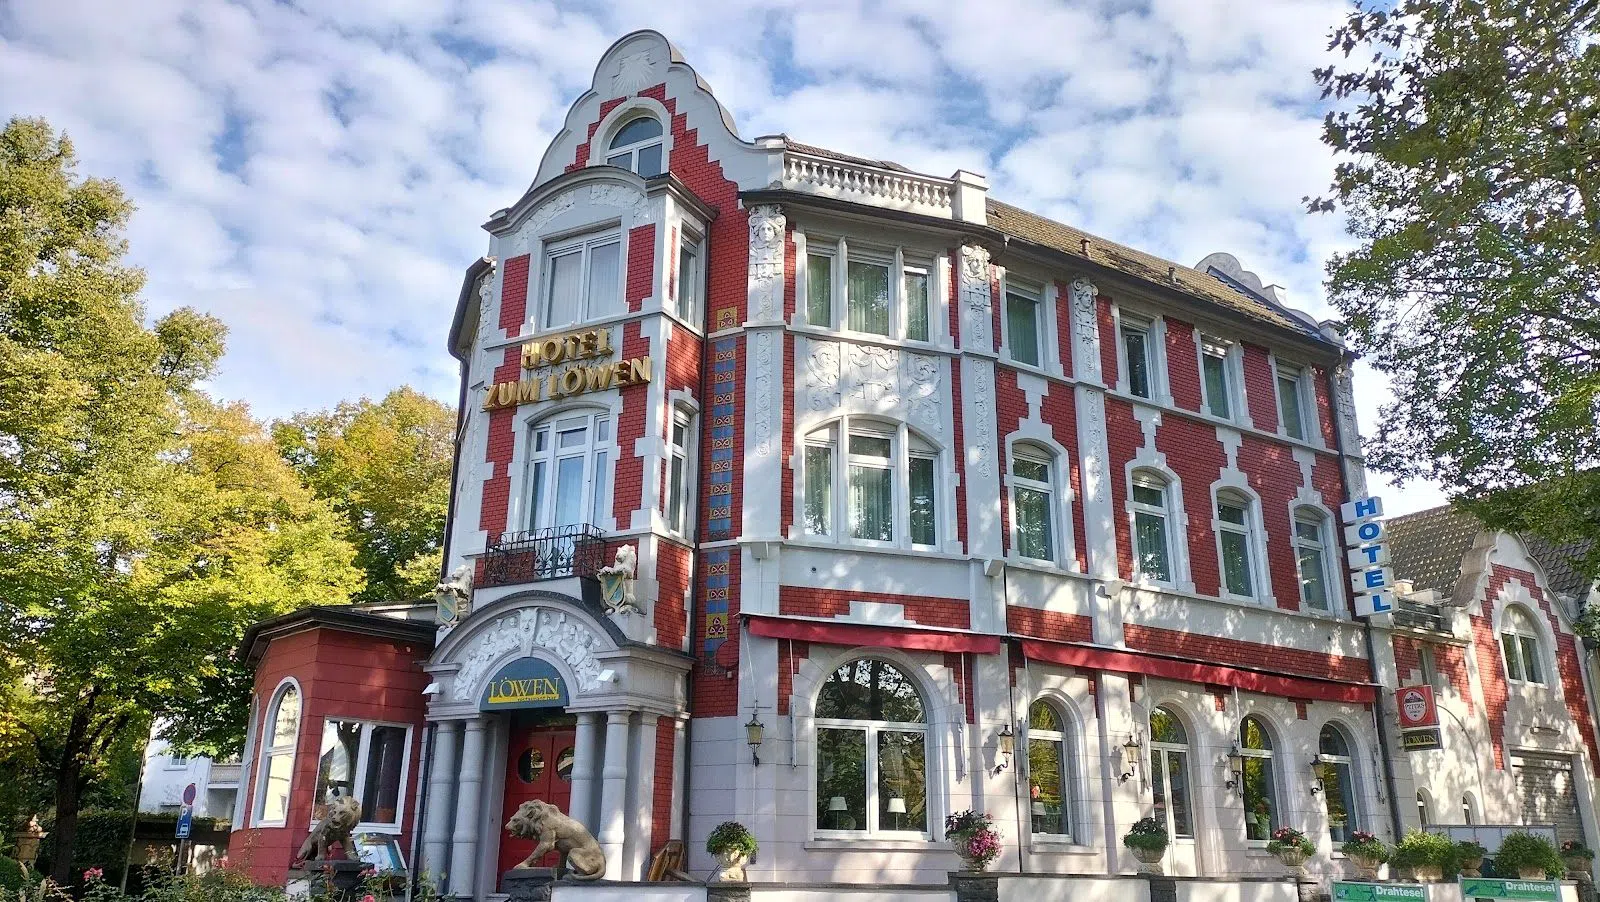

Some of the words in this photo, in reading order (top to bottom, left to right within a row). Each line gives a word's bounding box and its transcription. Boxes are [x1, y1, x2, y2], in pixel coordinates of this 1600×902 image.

[521, 328, 614, 369] HOTEL
[482, 378, 541, 410] ZUM
[548, 356, 651, 399] LÖWEN
[1355, 499, 1391, 612] HOTEL
[490, 677, 560, 698] LÖWEN
[181, 808, 188, 820] P
[1375, 885, 1424, 898] Drahtesel
[1505, 882, 1555, 892] Drahtesel
